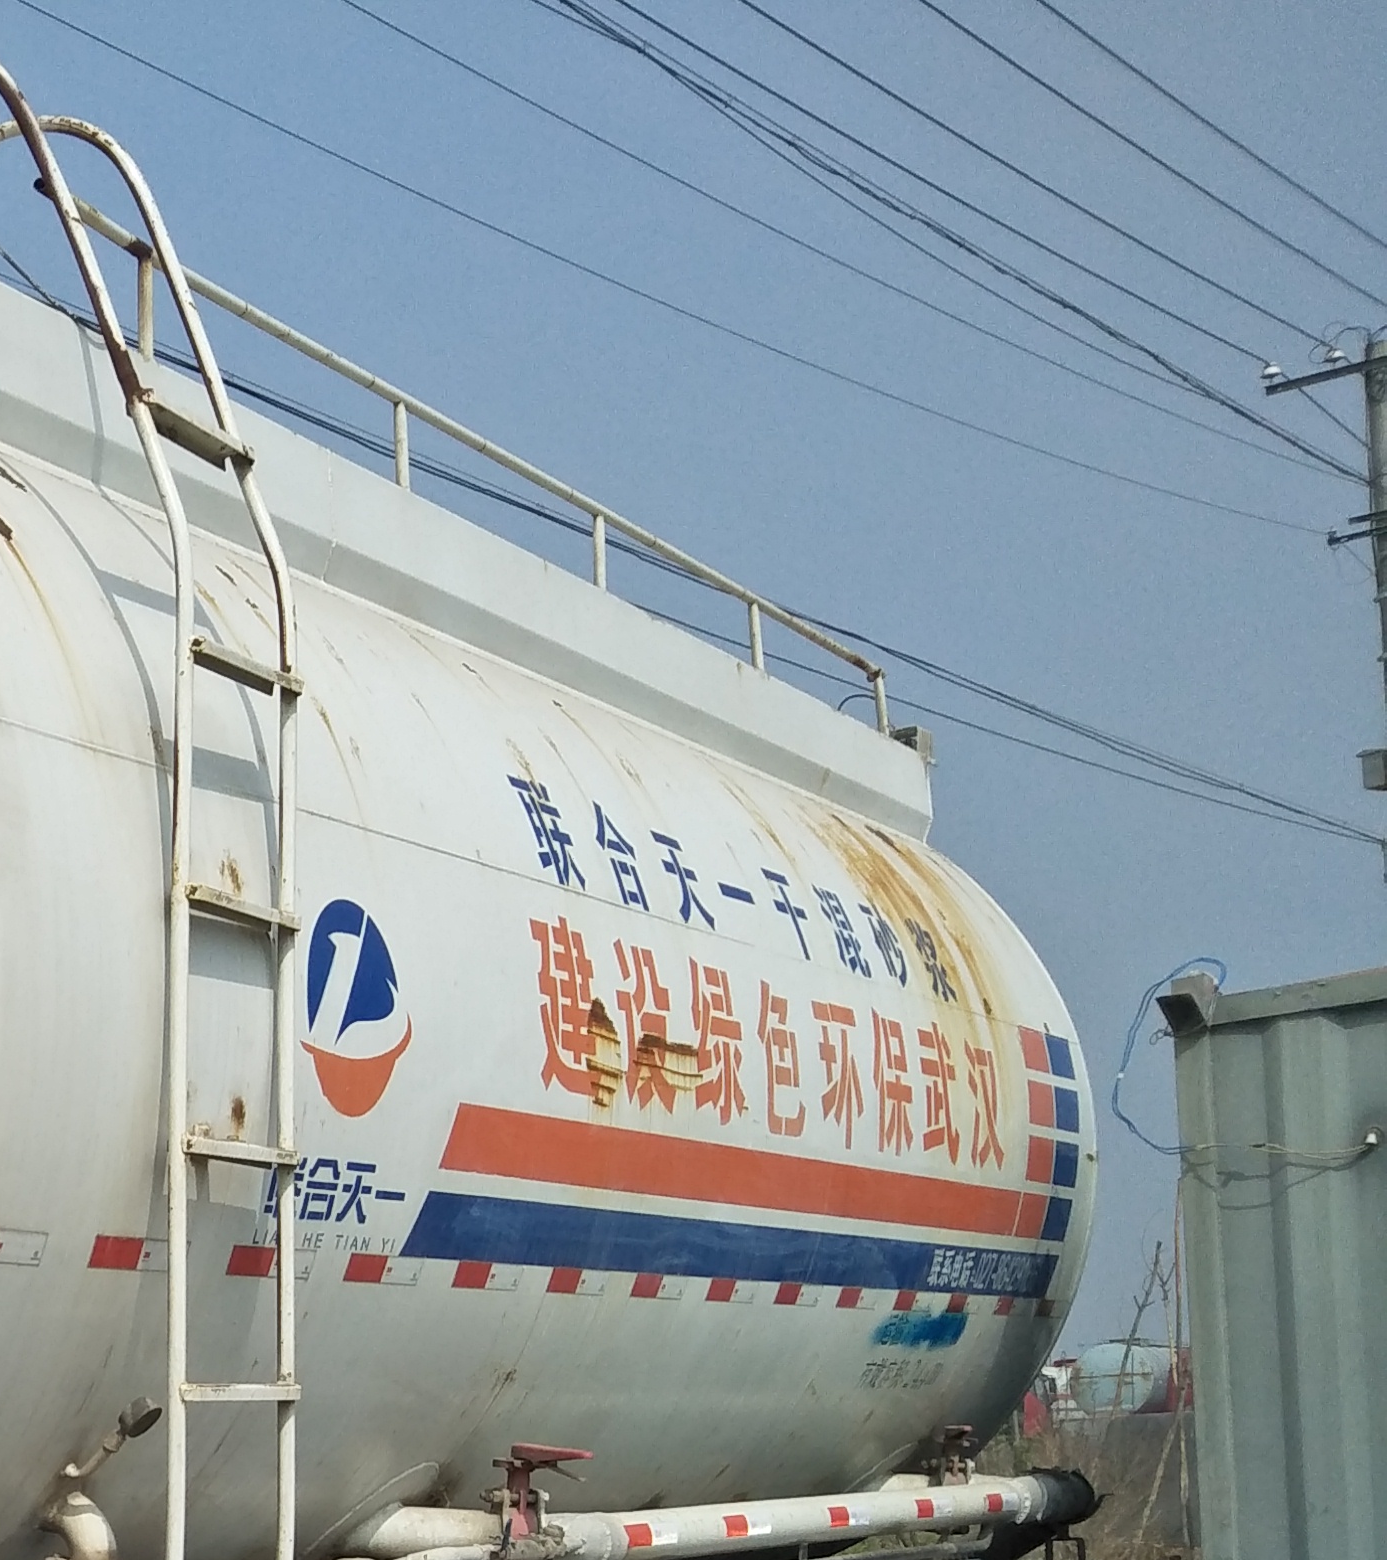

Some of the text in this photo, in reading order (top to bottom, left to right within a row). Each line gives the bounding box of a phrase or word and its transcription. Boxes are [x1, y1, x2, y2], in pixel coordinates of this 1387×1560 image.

[507, 774, 957, 1002] 联合天一干混砂浆
[529, 915, 1006, 1171] 建设绿色环保武汉
[301, 1231, 325, 1249] HE
[335, 1234, 372, 1252] TIAN
[381, 1237, 396, 1253] YI
